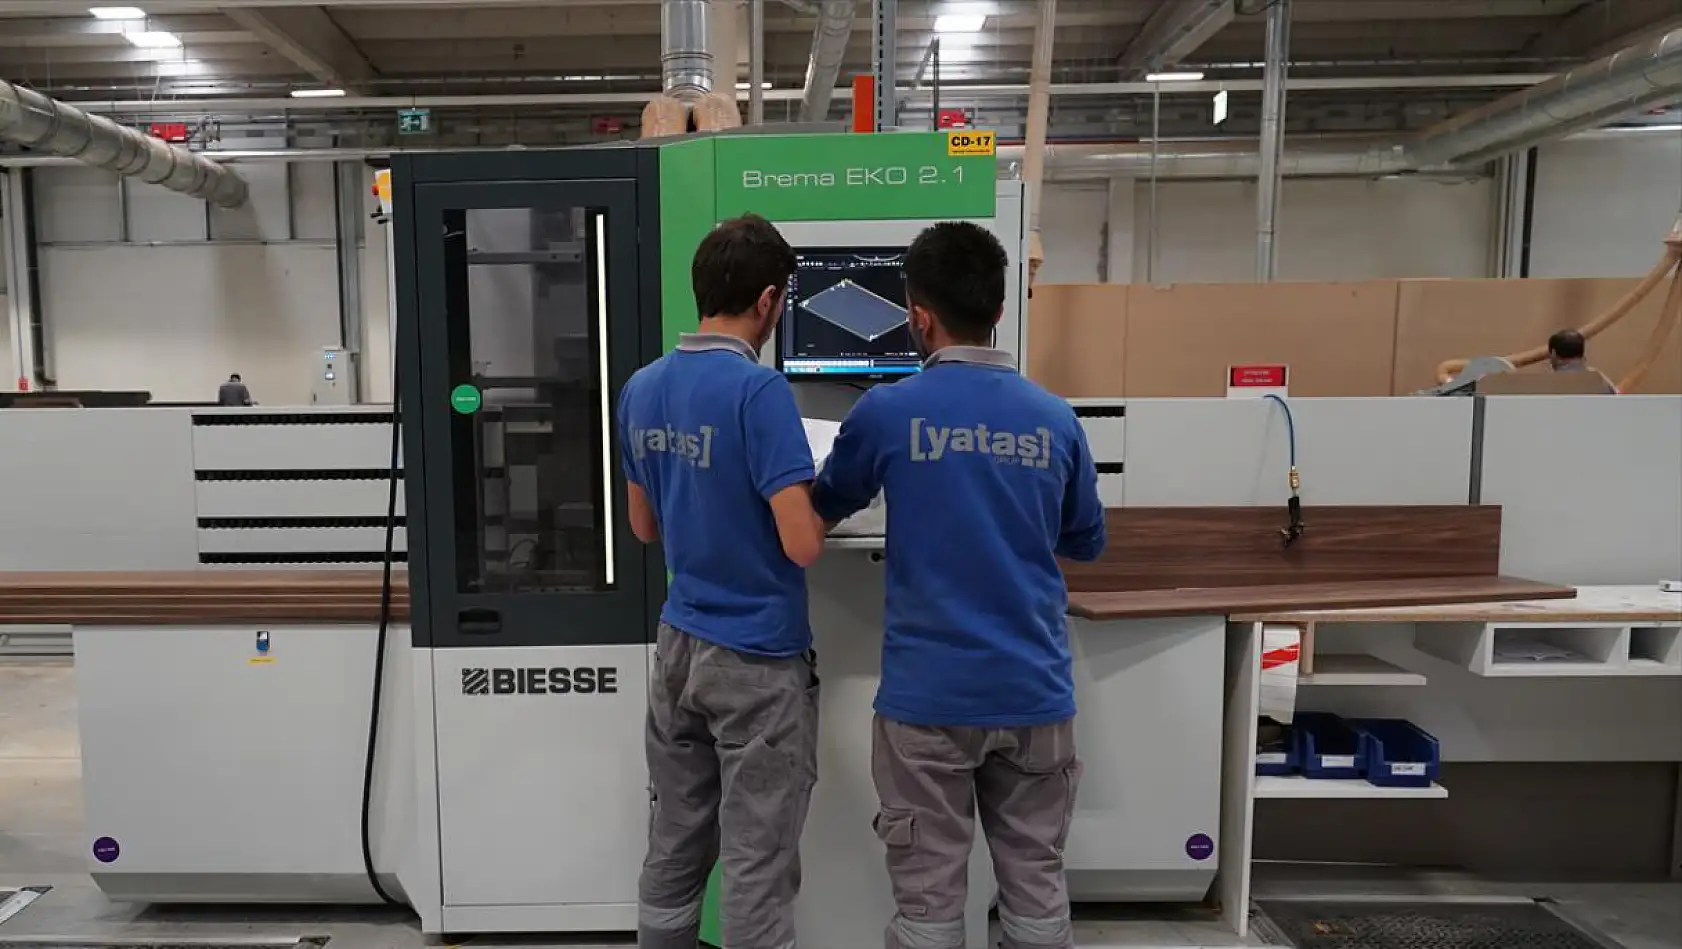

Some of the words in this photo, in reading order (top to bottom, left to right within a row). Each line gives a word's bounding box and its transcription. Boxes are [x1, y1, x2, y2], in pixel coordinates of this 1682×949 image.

[951, 136, 991, 146] CD-17
[742, 169, 835, 188] Brema
[846, 167, 907, 185] EKO
[918, 165, 964, 184] 2.1
[492, 667, 617, 694] BIESSE
